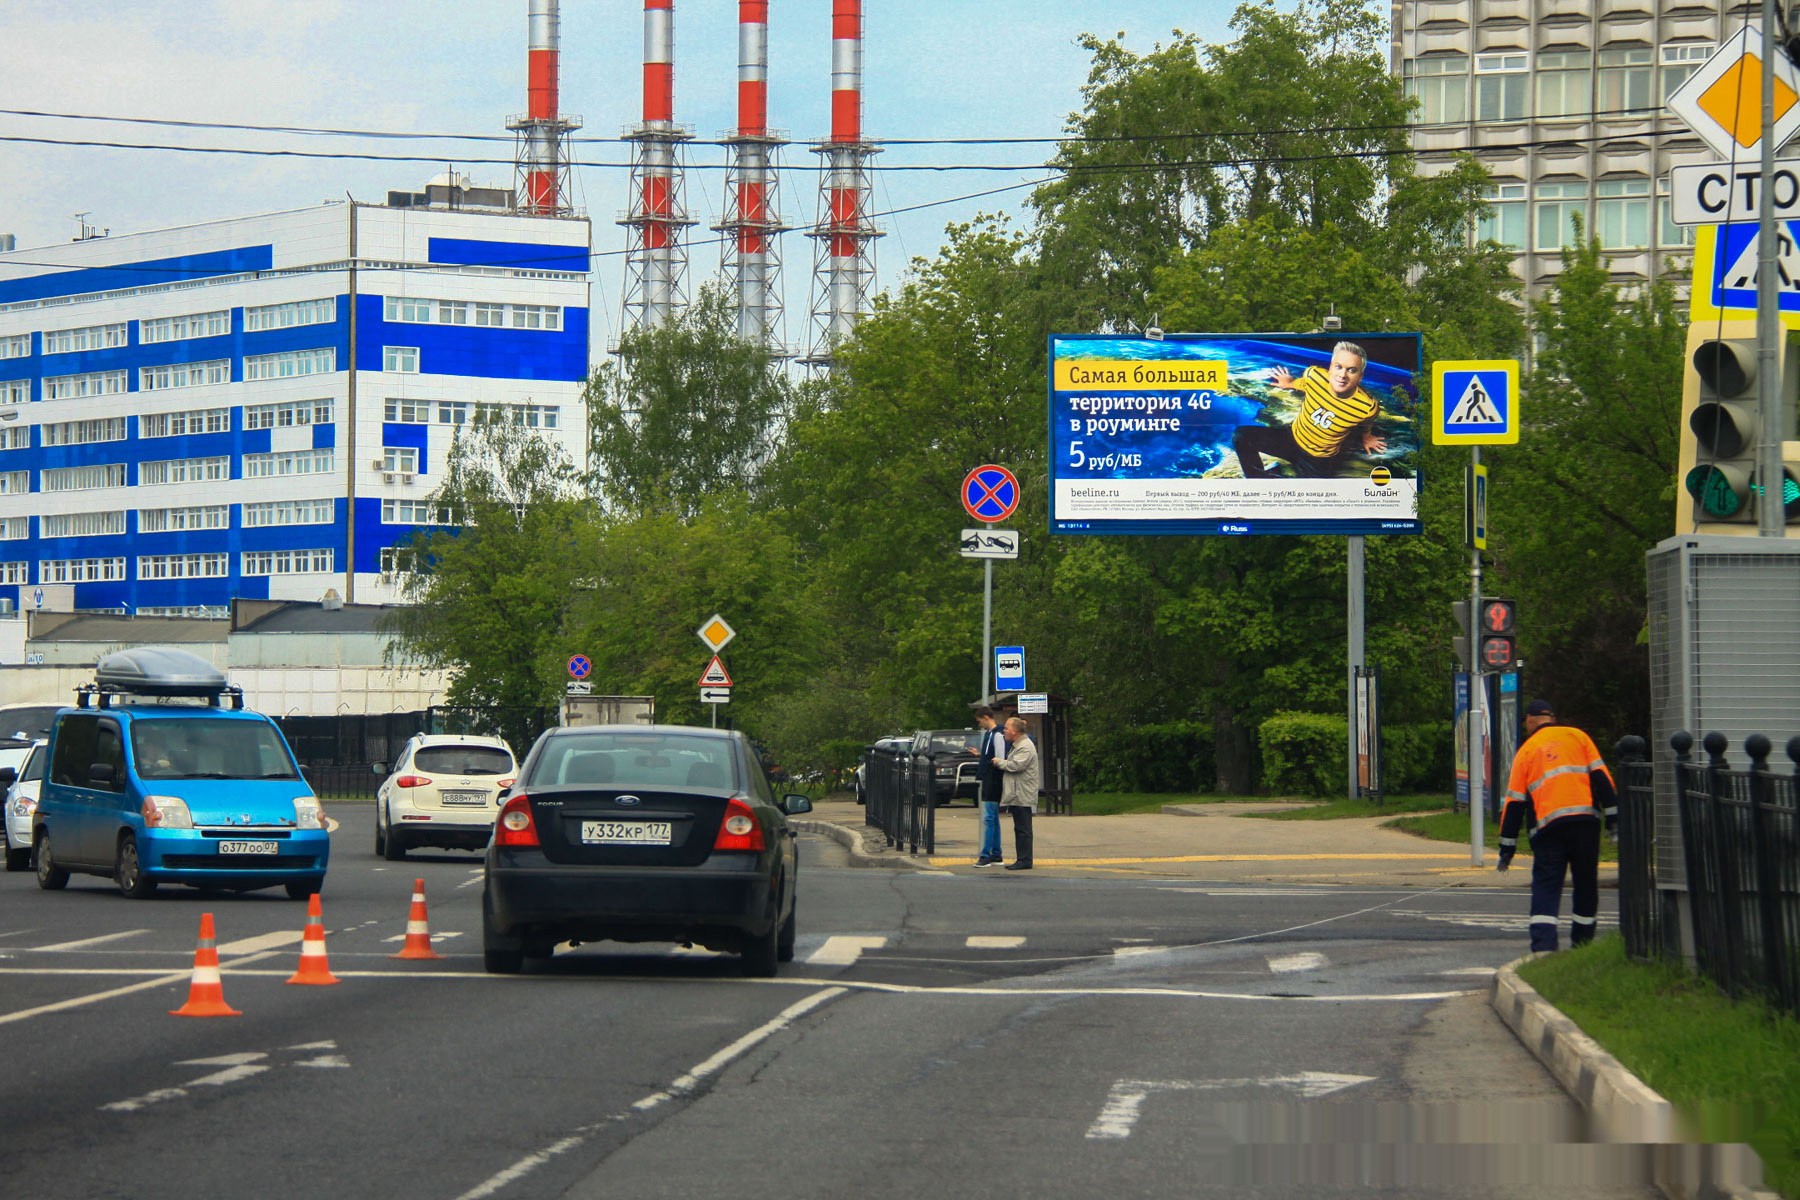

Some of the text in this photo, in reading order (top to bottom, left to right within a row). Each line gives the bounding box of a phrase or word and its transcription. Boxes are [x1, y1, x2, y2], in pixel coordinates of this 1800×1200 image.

[1069, 365, 1218, 384] Самая большая
[1069, 392, 1212, 414] территория 4G
[1069, 417, 1181, 436] в роуминге
[1310, 407, 1335, 429] 4G
[1069, 440, 1142, 470] 5 руб/МБ
[1070, 488, 1120, 497] beeline.ru
[1273, 490, 1296, 498] руб/МБ
[1364, 488, 1398, 497] Билайн
[1488, 640, 1511, 664] 23
[587, 823, 668, 838] У332КР 177
[222, 842, 275, 853] О377ОО 07
